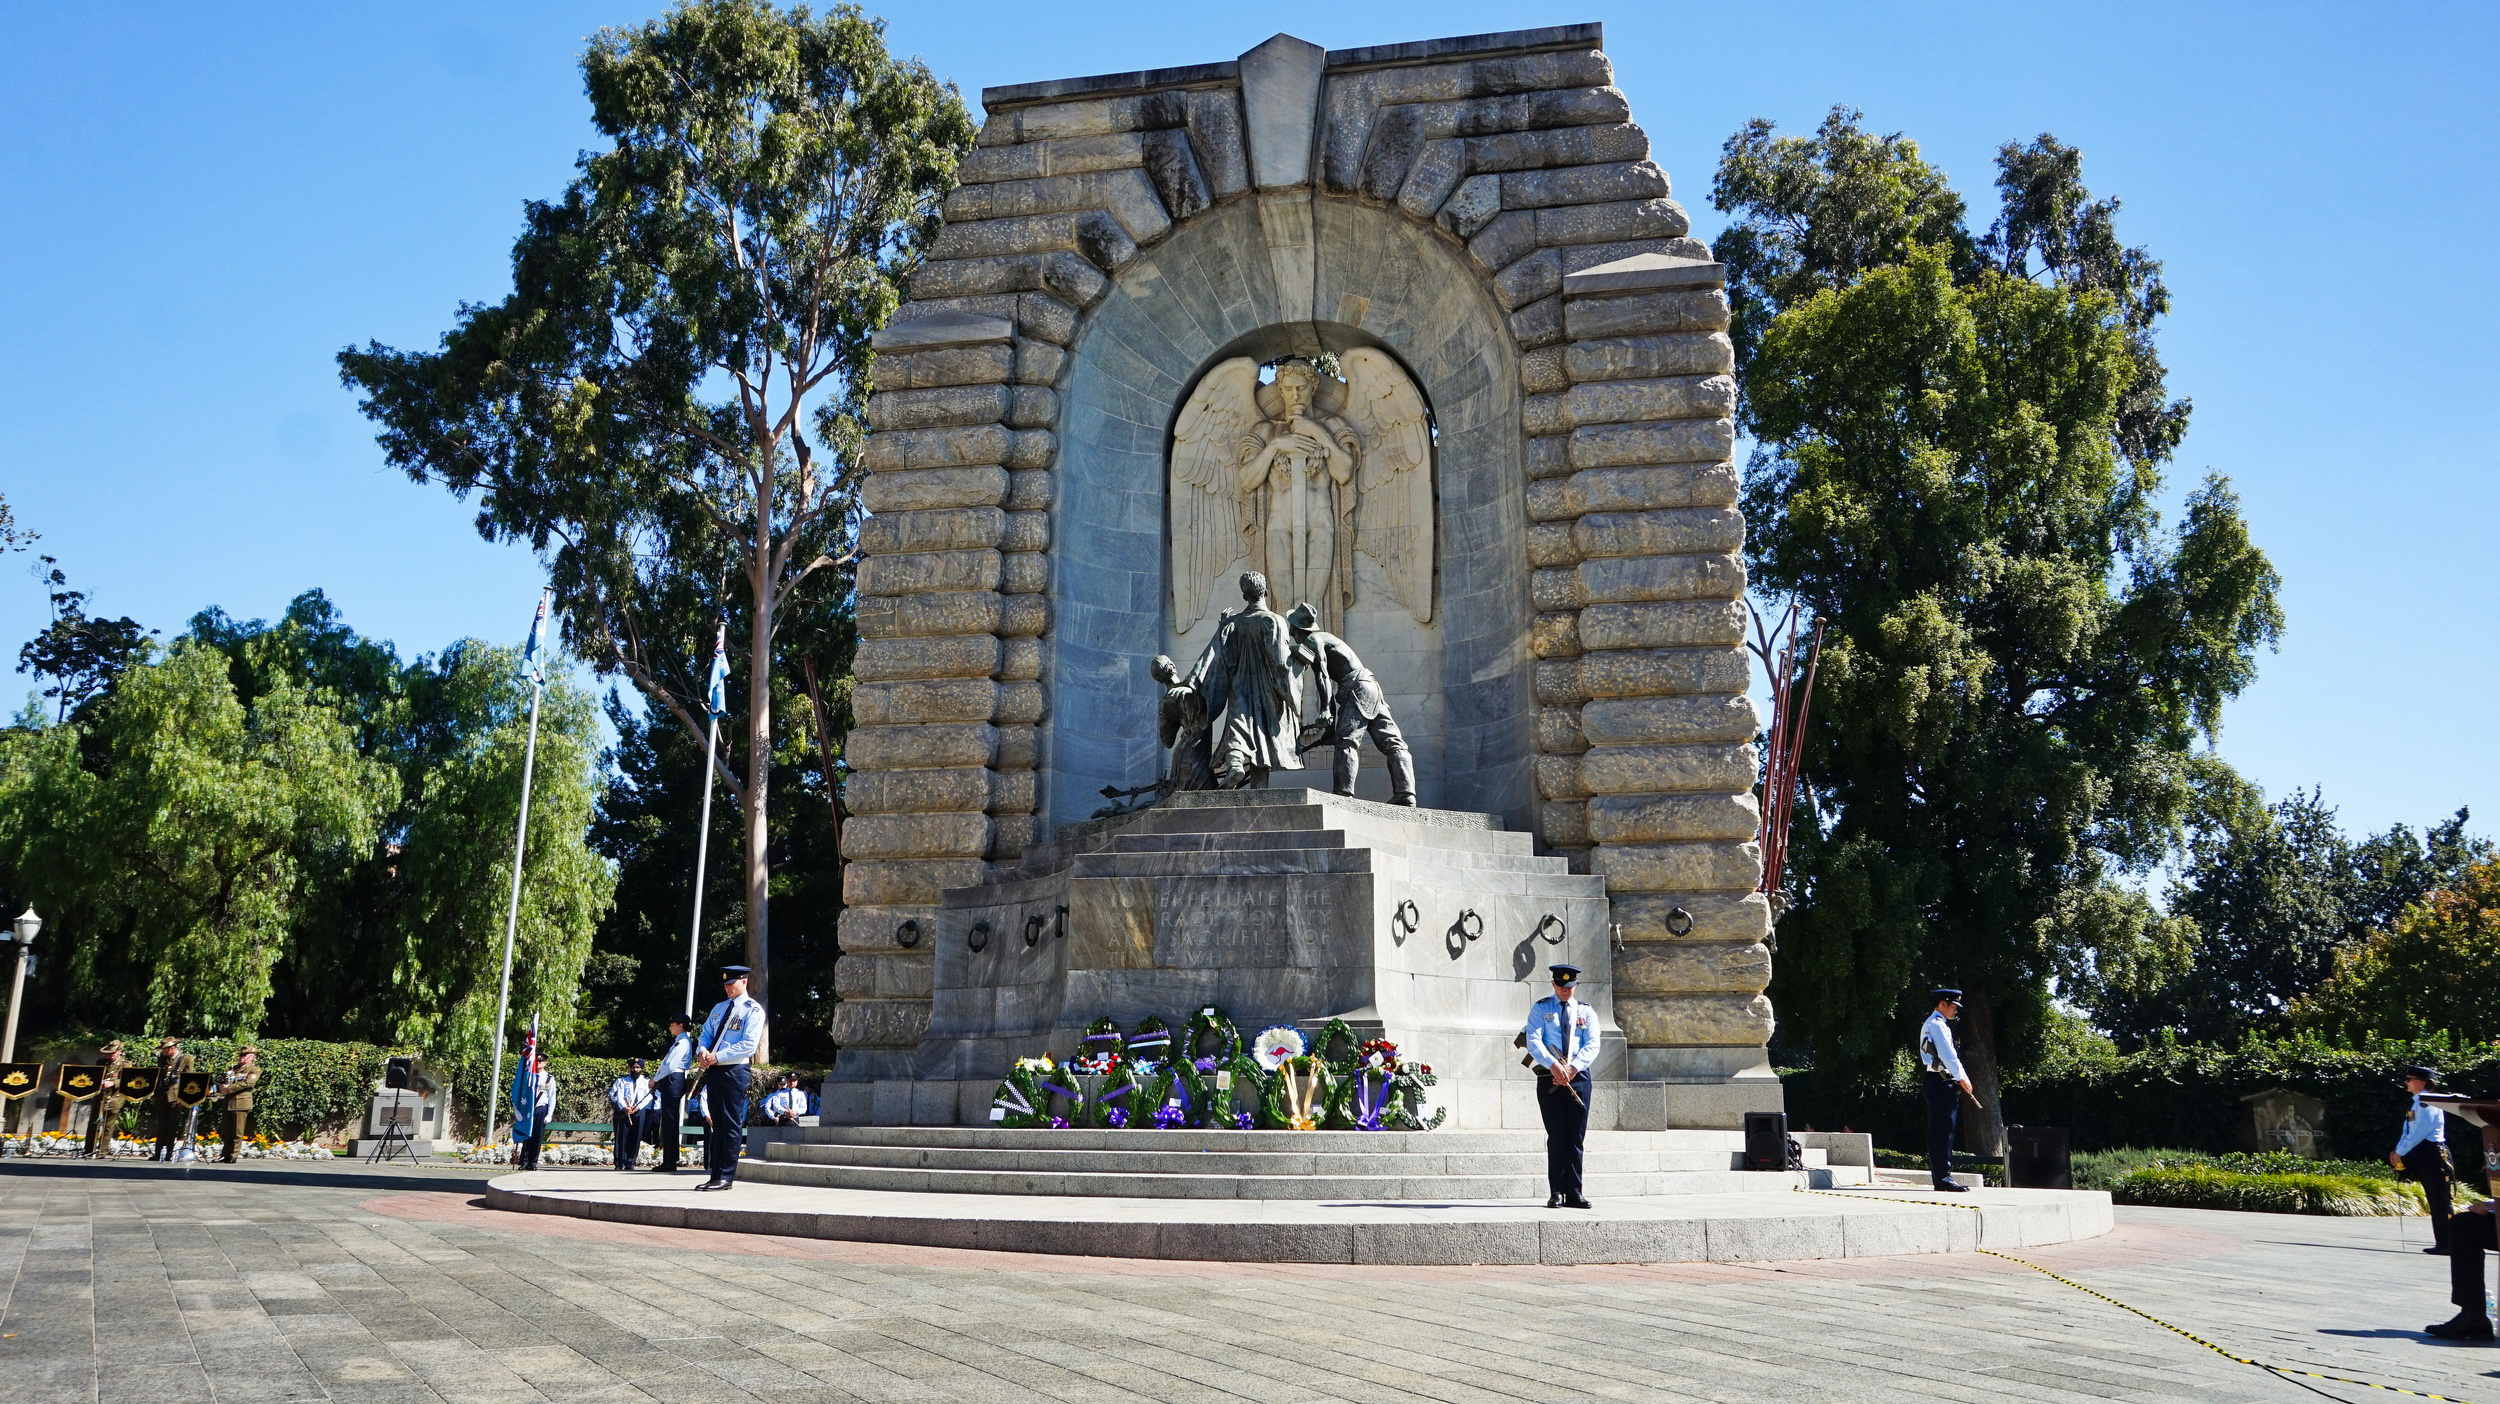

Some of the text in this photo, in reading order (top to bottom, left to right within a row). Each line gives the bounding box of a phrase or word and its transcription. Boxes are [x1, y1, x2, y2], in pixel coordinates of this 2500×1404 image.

[1108, 892, 1135, 908] TO
[1291, 889, 1332, 906] THE
[1107, 909, 1332, 928] CORAGE LOYATY
[1107, 931, 1154, 947] AN
[1303, 928, 1332, 946] OF
